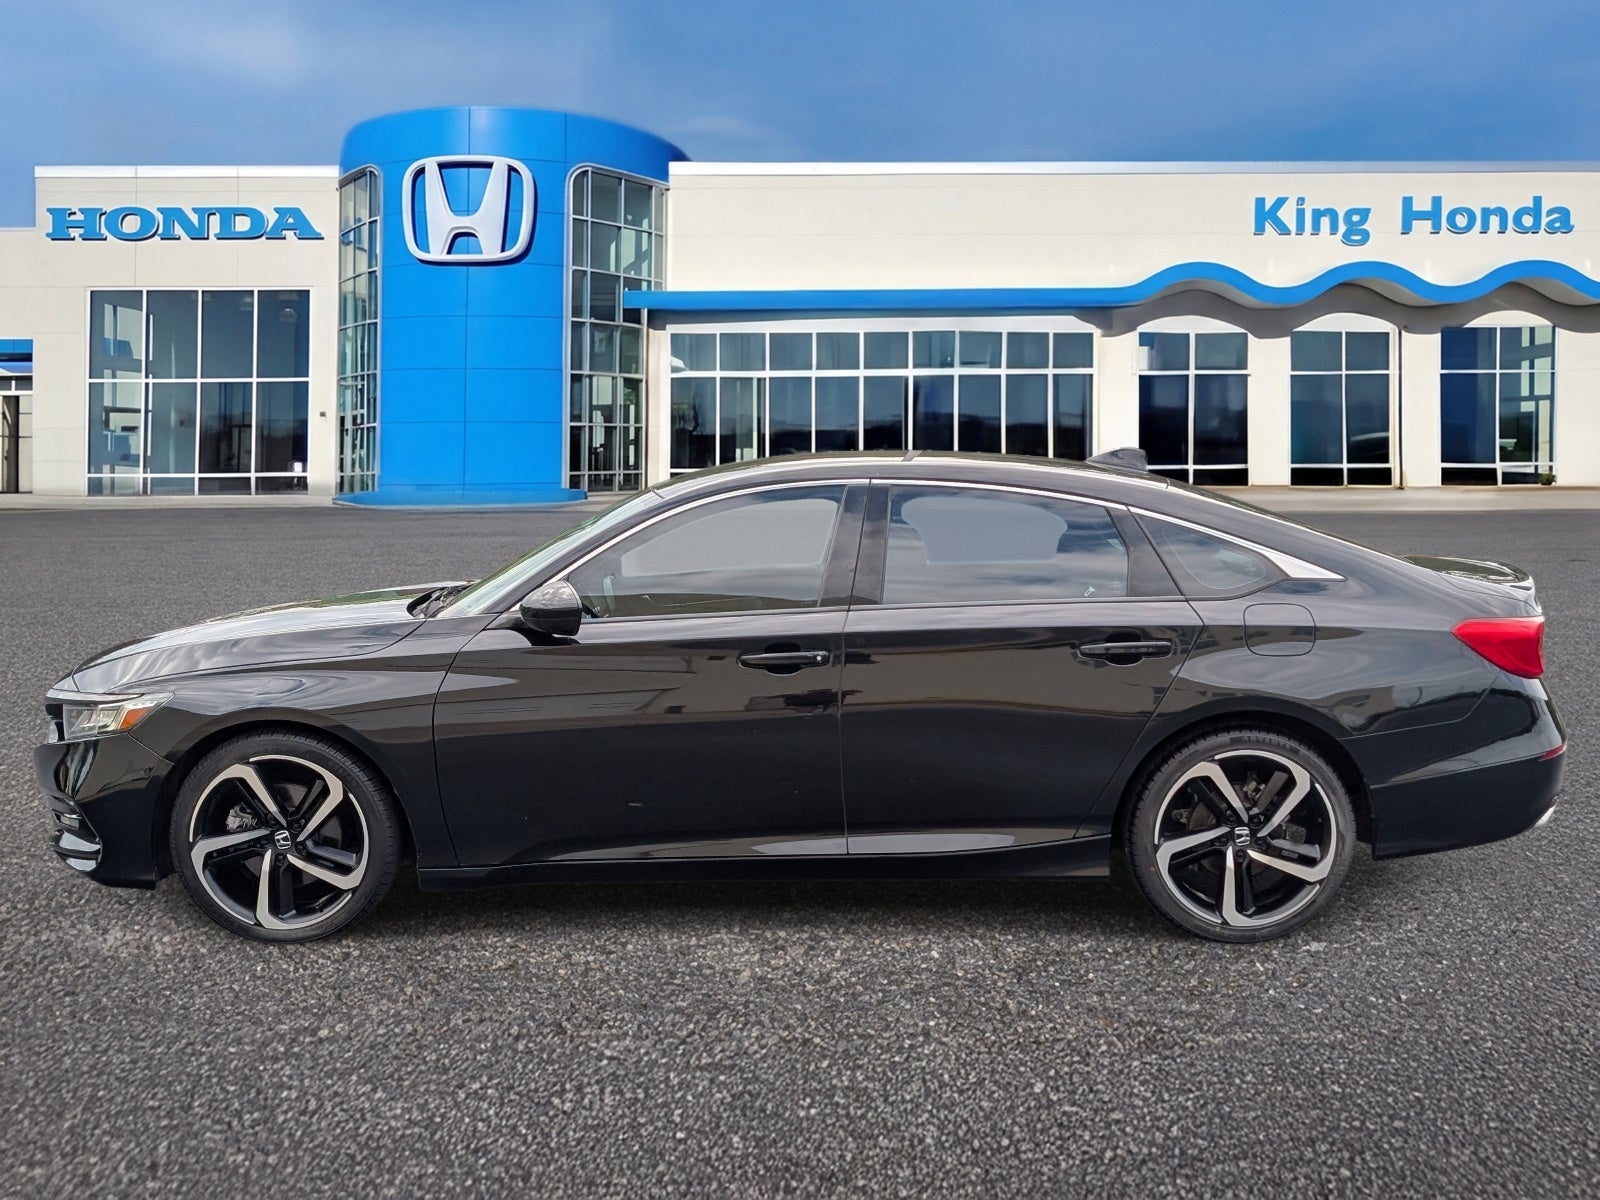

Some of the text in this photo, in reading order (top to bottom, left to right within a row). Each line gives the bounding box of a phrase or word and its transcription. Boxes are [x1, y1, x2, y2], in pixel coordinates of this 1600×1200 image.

[45, 206, 325, 241] HONDA
[1252, 195, 1575, 247] King Honda
